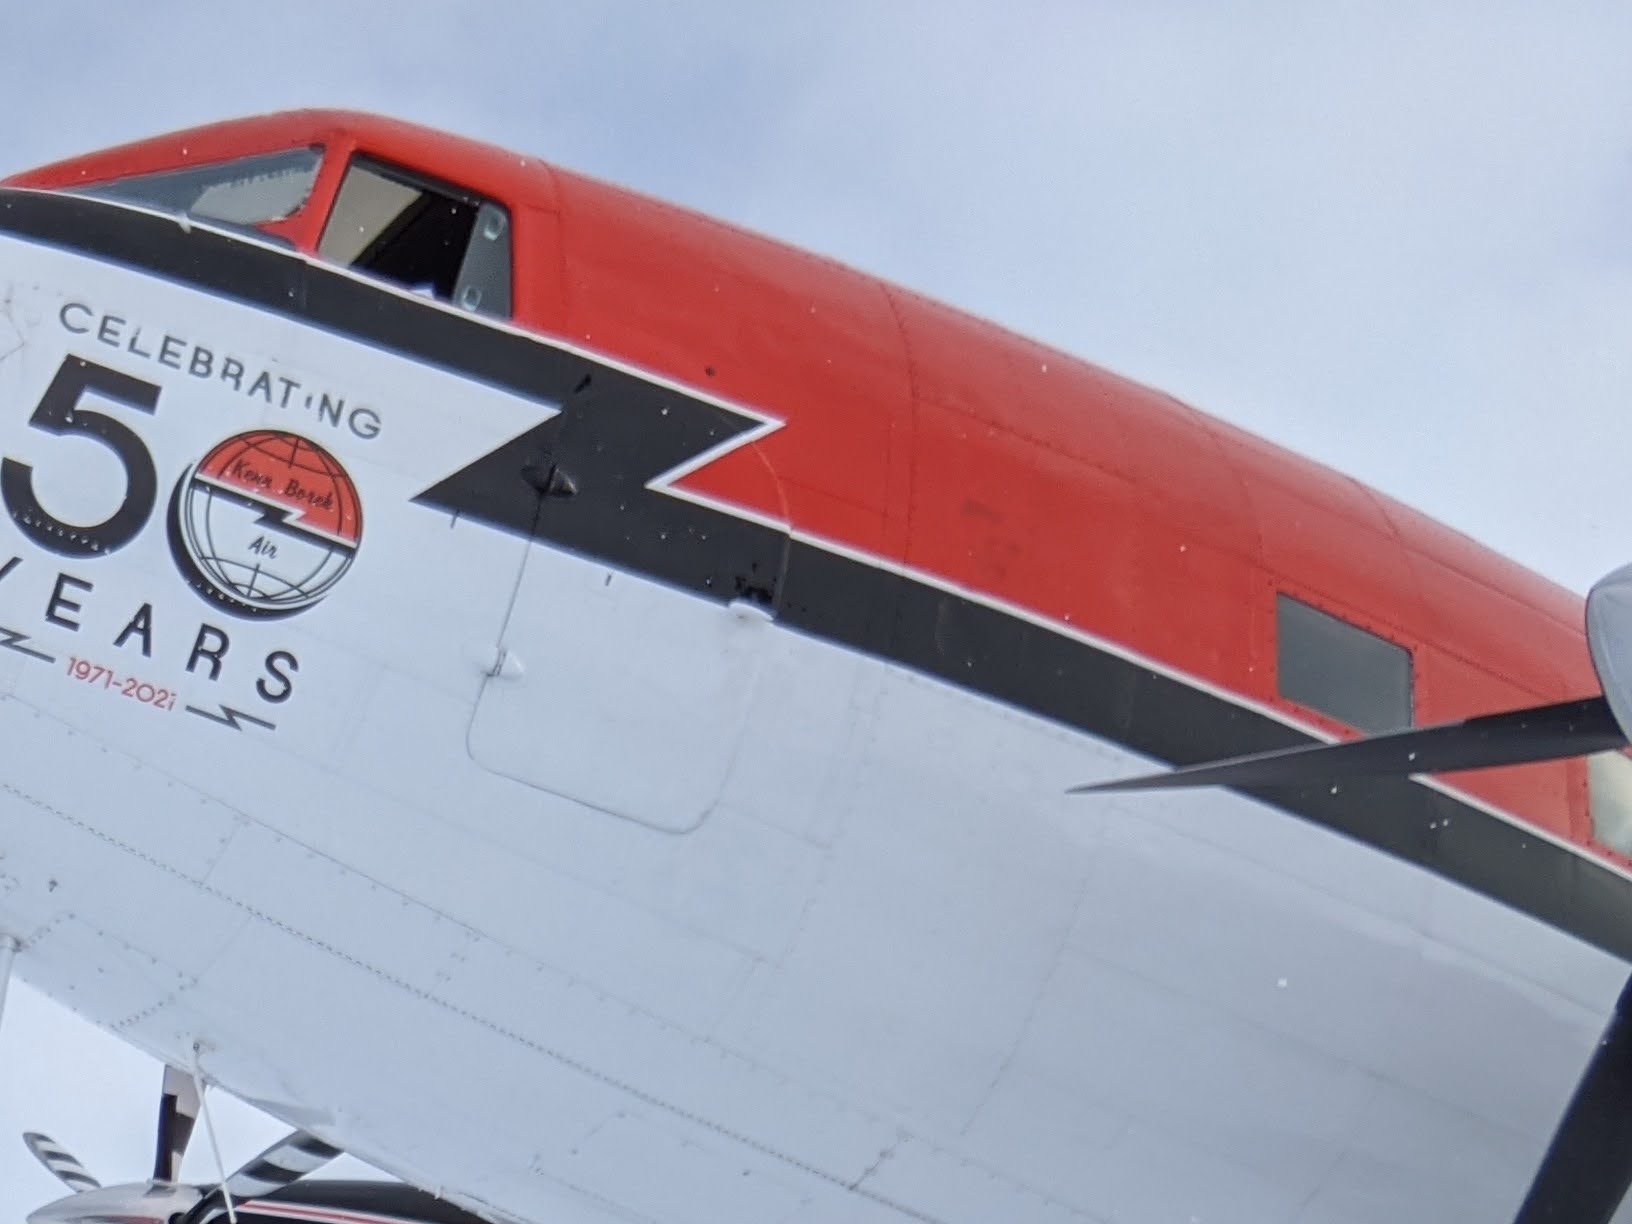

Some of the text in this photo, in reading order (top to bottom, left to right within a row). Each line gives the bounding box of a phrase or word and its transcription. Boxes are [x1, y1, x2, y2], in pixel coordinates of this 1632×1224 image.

[58, 302, 382, 440] CELEBRATING
[247, 535, 278, 560] Air
[66, 657, 177, 712] 1971-2021
